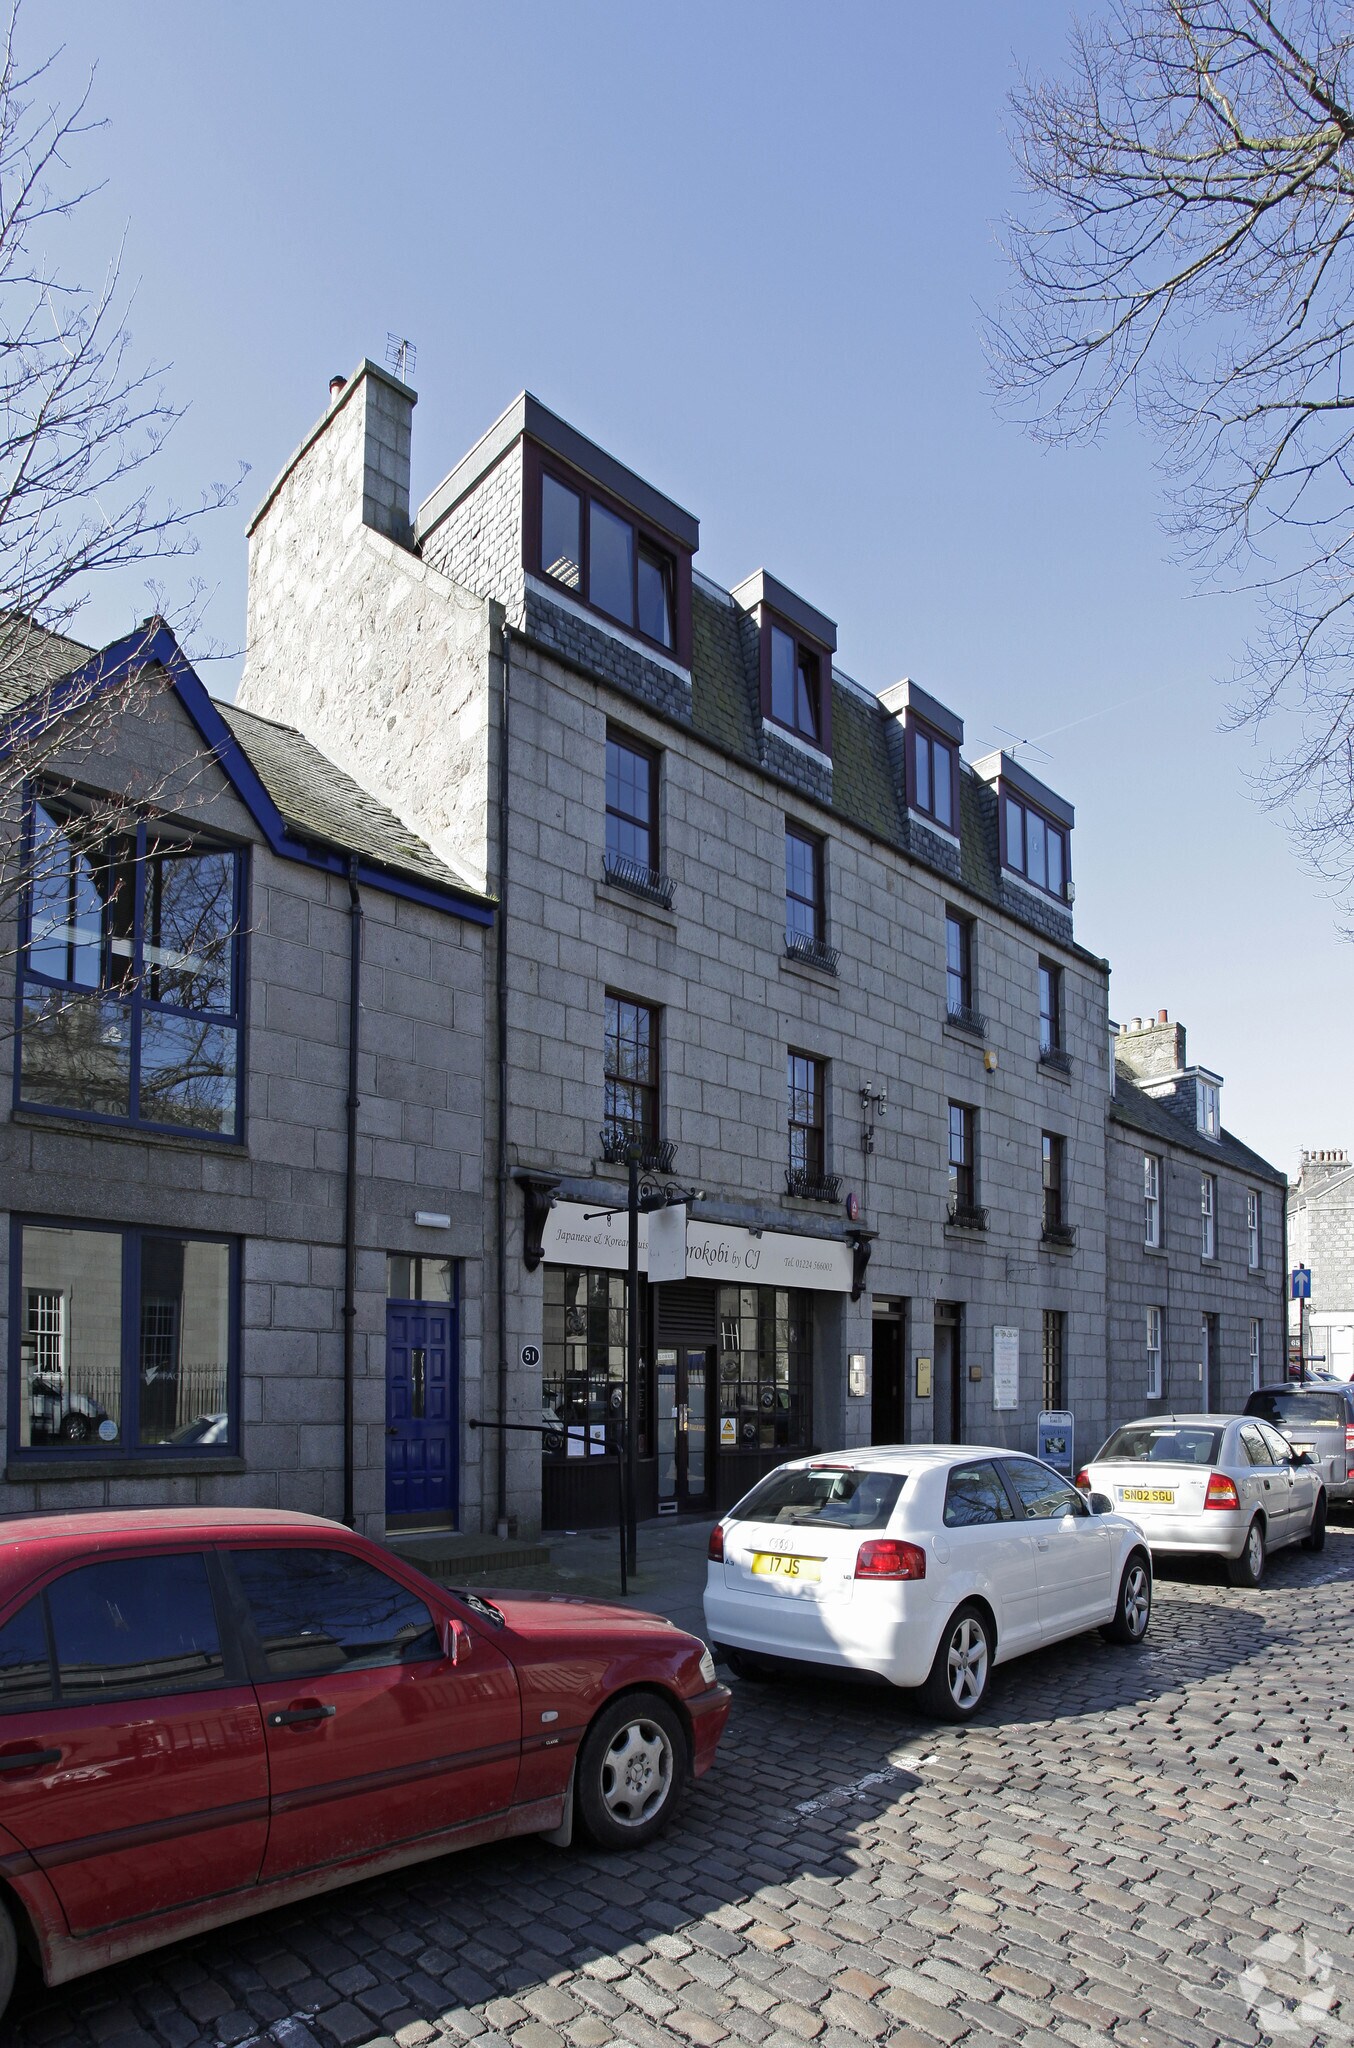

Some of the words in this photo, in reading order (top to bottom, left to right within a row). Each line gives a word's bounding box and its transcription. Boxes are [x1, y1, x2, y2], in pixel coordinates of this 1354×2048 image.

[556, 1229, 592, 1243] Japanese
[594, 1233, 603, 1244] &
[731, 1251, 742, 1269] by
[744, 1249, 761, 1270] CJ
[525, 1350, 535, 1361] 51
[1124, 1489, 1150, 1501] SN02
[1152, 1490, 1172, 1502] SGU
[769, 1556, 781, 1572] 17
[784, 1558, 801, 1575] JS
